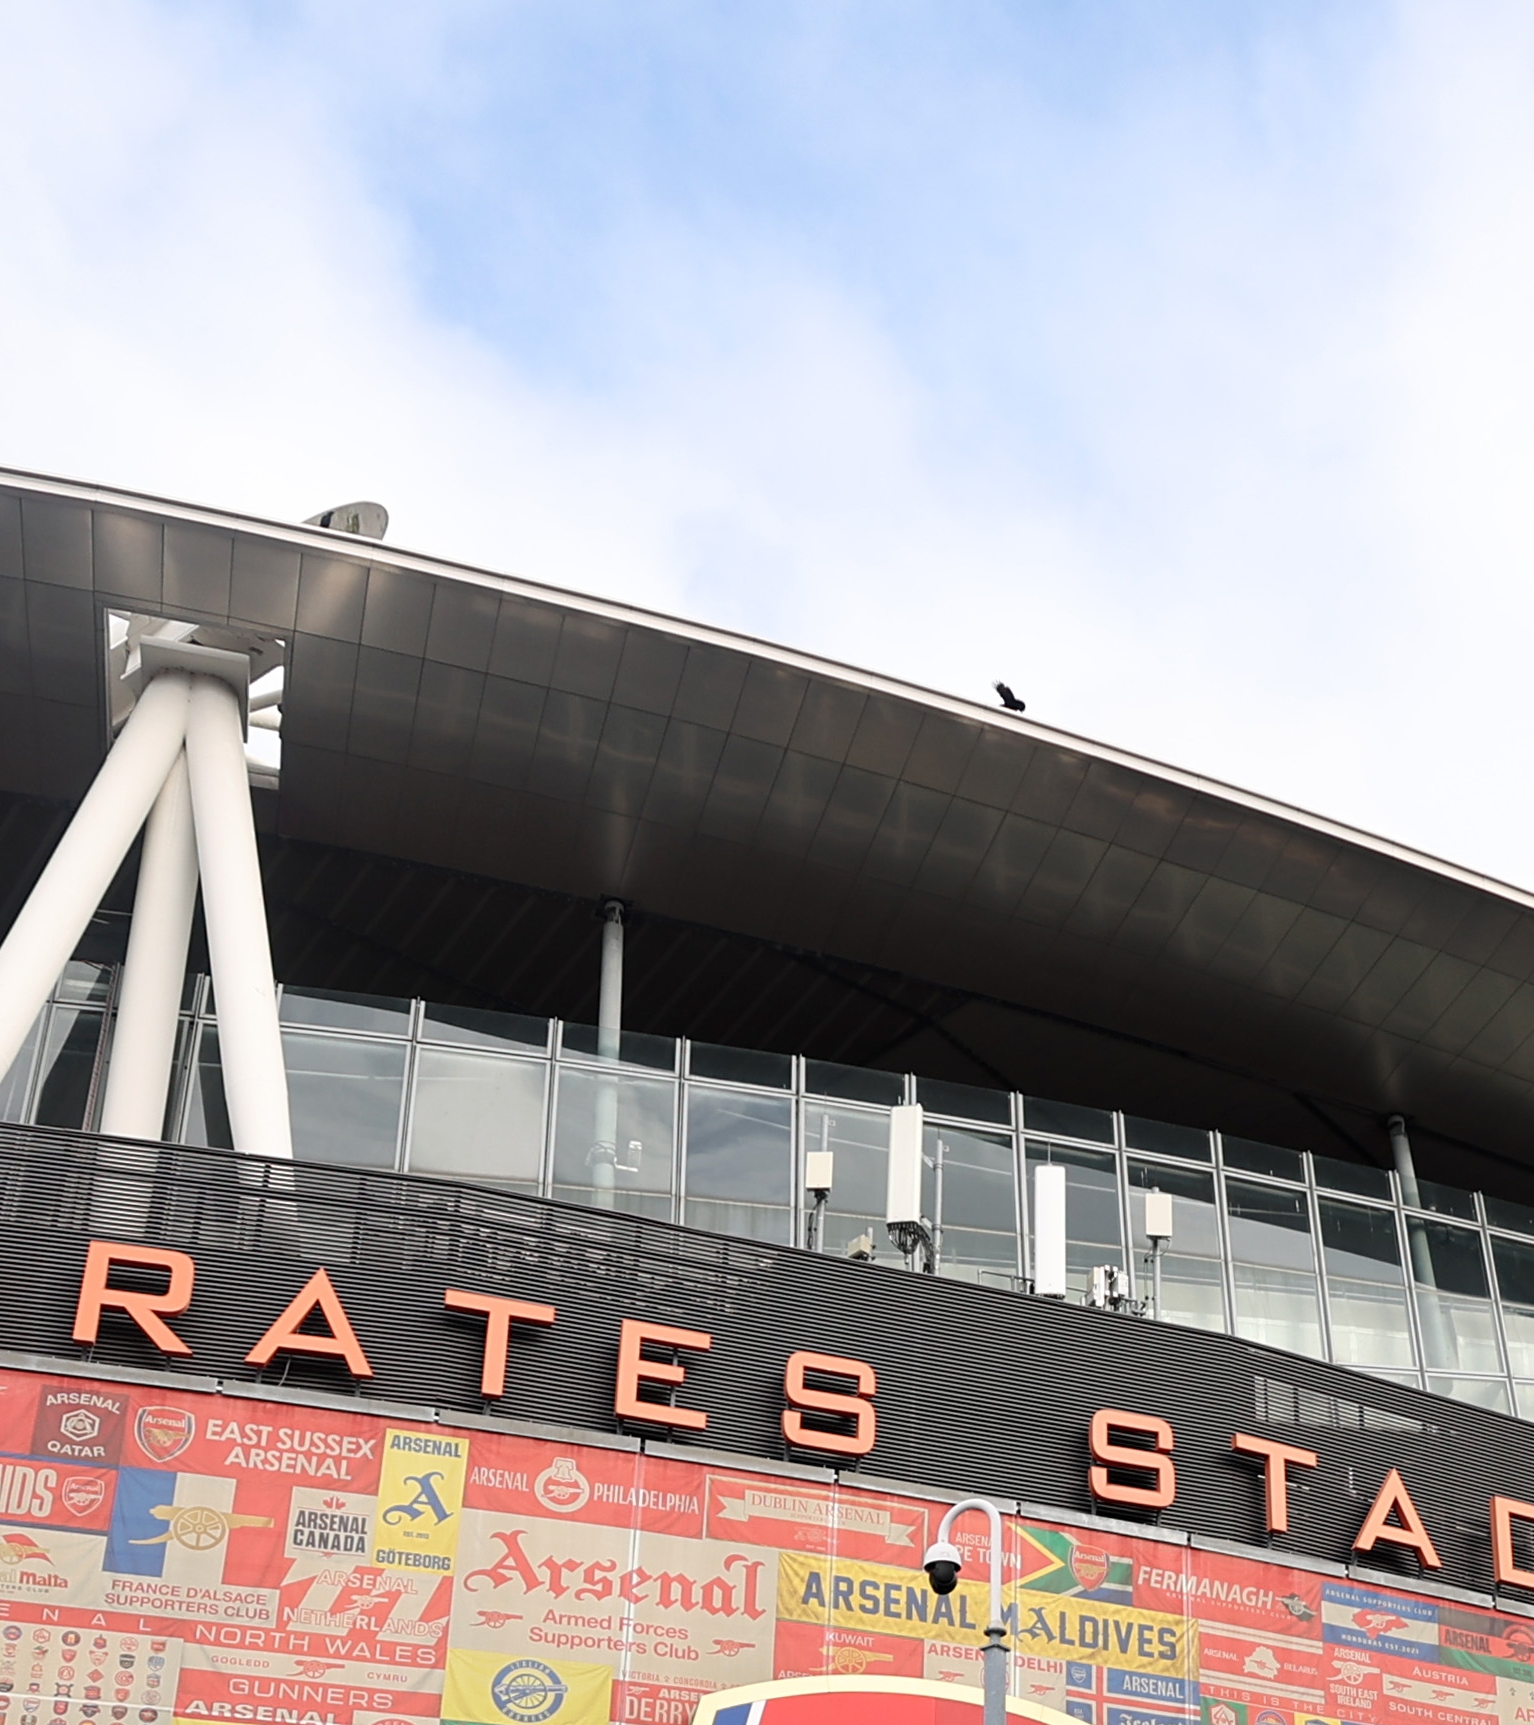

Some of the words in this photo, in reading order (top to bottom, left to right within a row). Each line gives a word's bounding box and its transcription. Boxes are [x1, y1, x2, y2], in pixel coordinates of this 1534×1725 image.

[47, 1439, 106, 1458] QATAR
[205, 1420, 289, 1448] EAST
[294, 1429, 375, 1459] SUSSEX
[293, 1529, 366, 1553] CANADA
[375, 1548, 451, 1571] GÖTEBORG
[463, 1530, 767, 1620] Arsenal
[1137, 1566, 1274, 1610] FERMANAGH
[104, 1592, 219, 1617] SUPPORTERS
[224, 1603, 270, 1620] CLUB
[542, 1608, 614, 1631] Armed
[619, 1616, 689, 1640] Forces
[195, 1624, 309, 1652] NORTH
[326, 1636, 437, 1664] WALES
[528, 1627, 646, 1654] Supporters
[653, 1637, 699, 1662] Club
